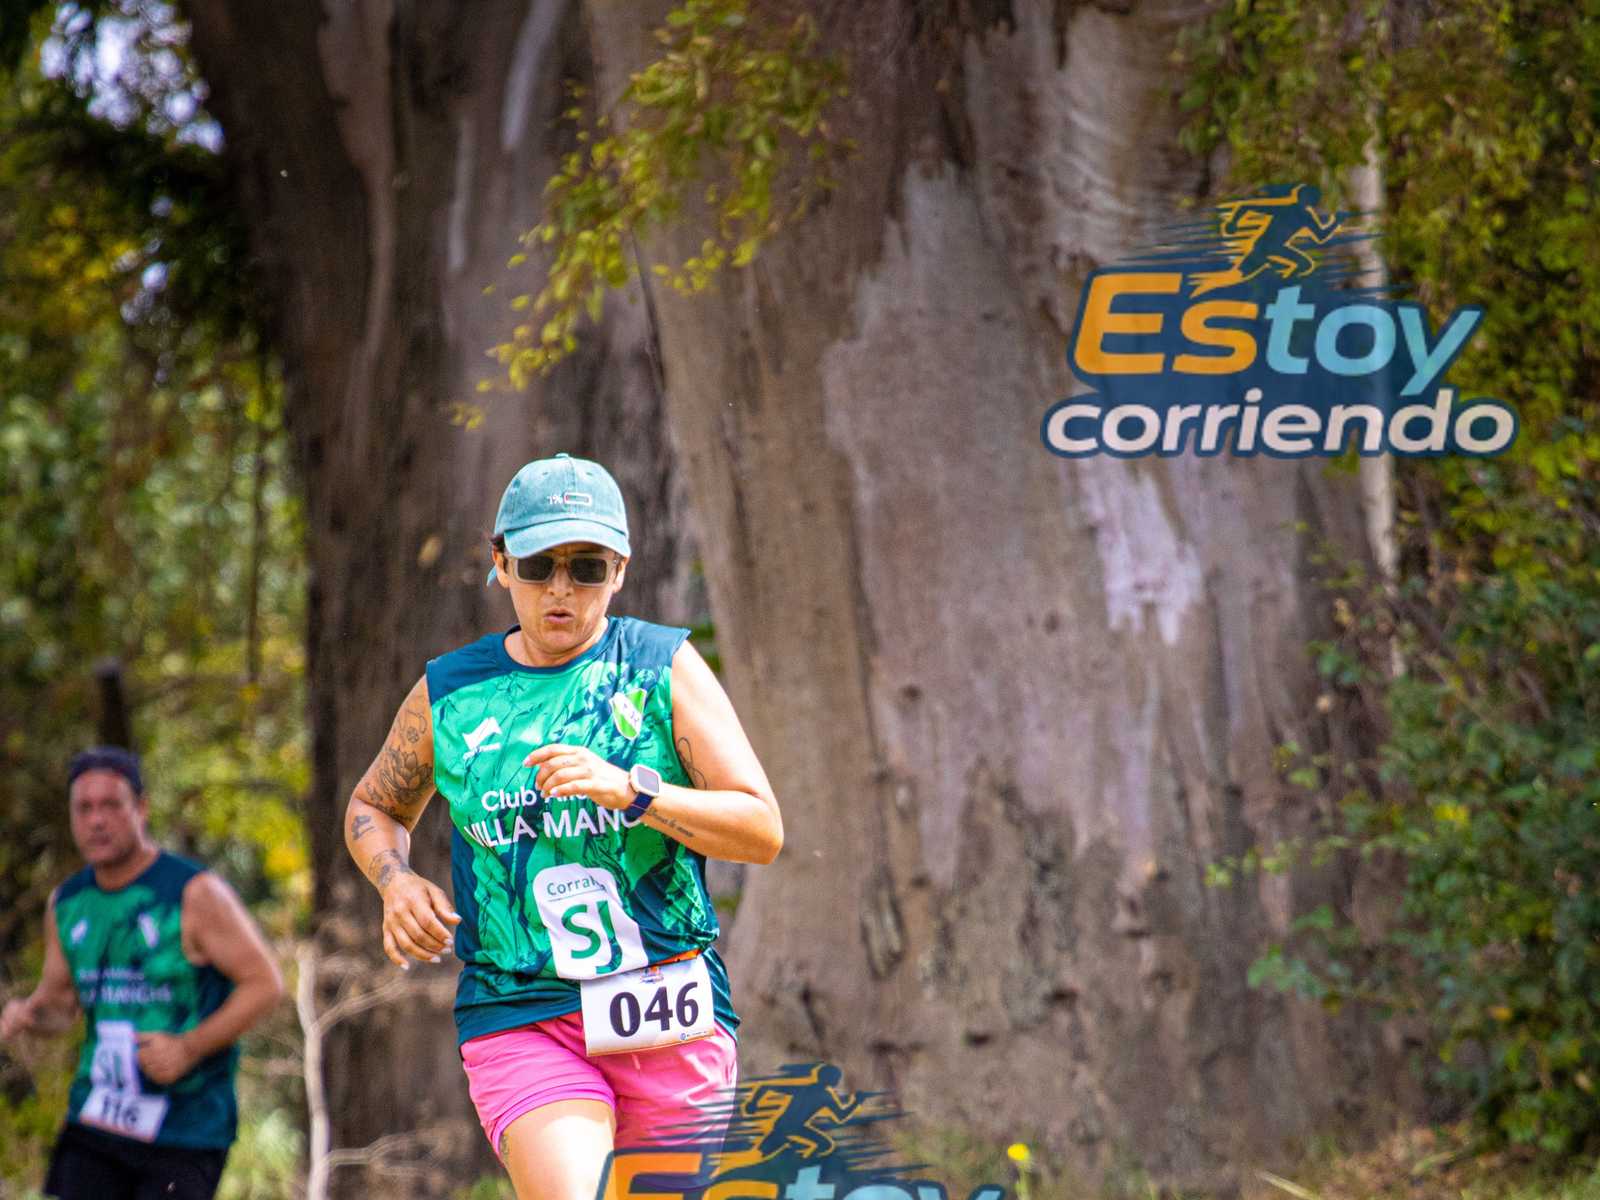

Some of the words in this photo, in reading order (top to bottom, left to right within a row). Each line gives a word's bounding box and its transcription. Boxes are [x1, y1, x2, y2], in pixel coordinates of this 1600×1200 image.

[481, 786, 537, 812] Club
[464, 815, 537, 847] VILLA
[561, 900, 623, 974] SJ
[609, 981, 699, 1037] 046
